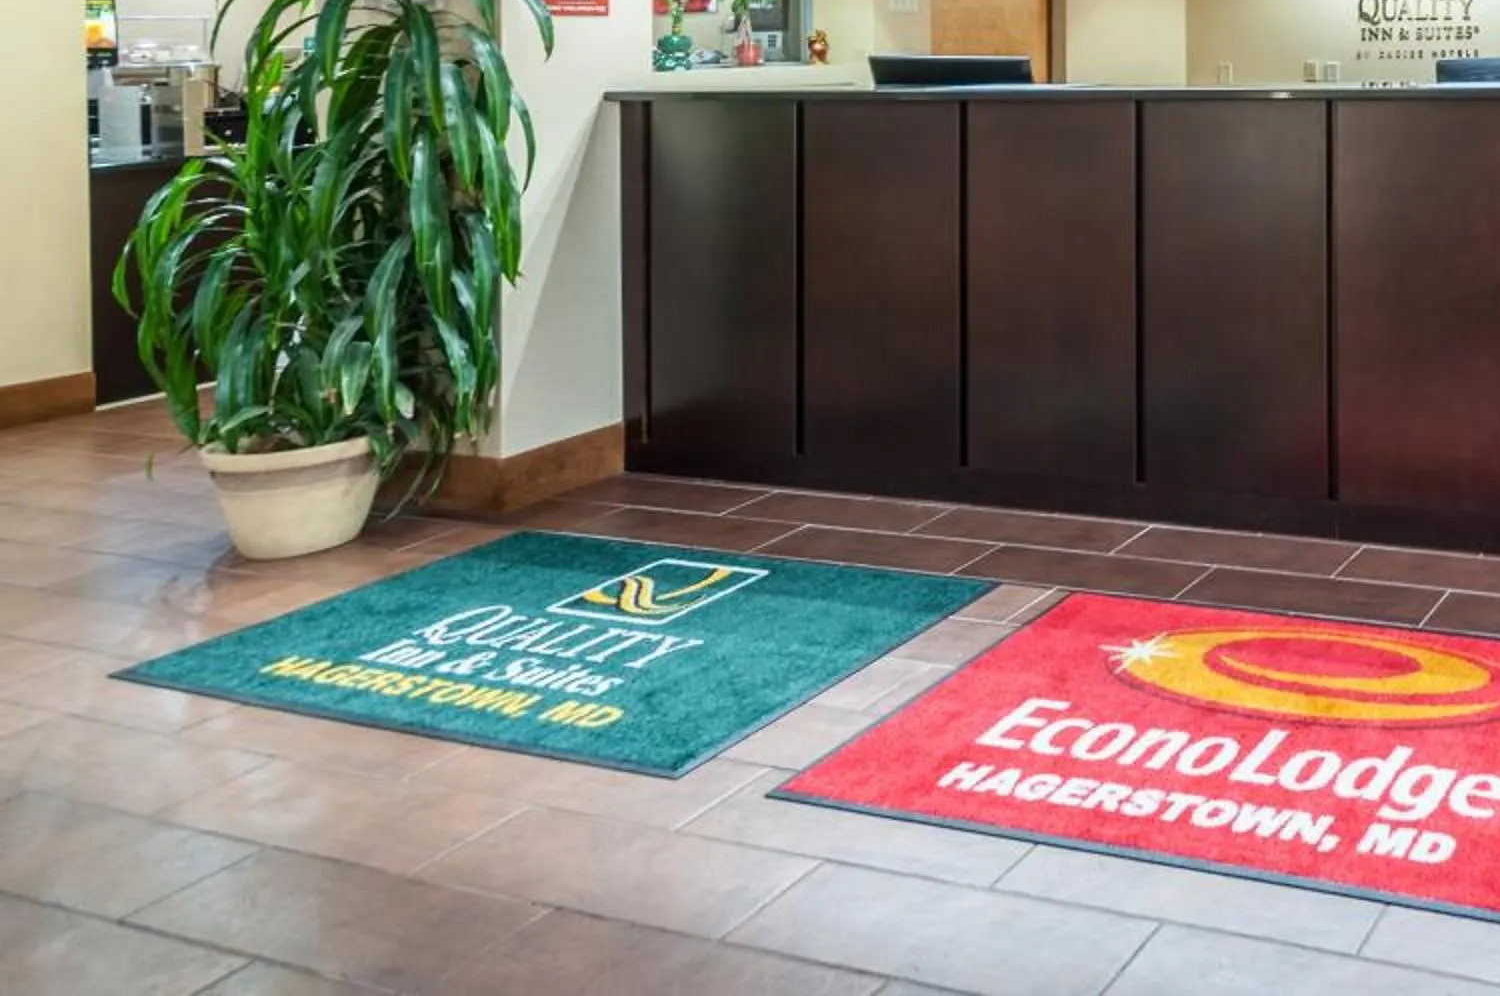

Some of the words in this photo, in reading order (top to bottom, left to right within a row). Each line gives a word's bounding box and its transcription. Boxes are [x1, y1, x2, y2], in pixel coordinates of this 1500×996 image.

[1360, 27, 1393, 41] INN
[1399, 27, 1409, 41] &
[357, 639, 447, 669] Inn
[436, 651, 498, 674] &
[482, 657, 625, 697] Suites
[412, 605, 704, 669] QUALITY
[258, 656, 543, 719] HAGERSTOWN,
[537, 699, 625, 728] MD
[937, 760, 1342, 853] HAGERSTOWN,
[1356, 822, 1457, 864] MD
